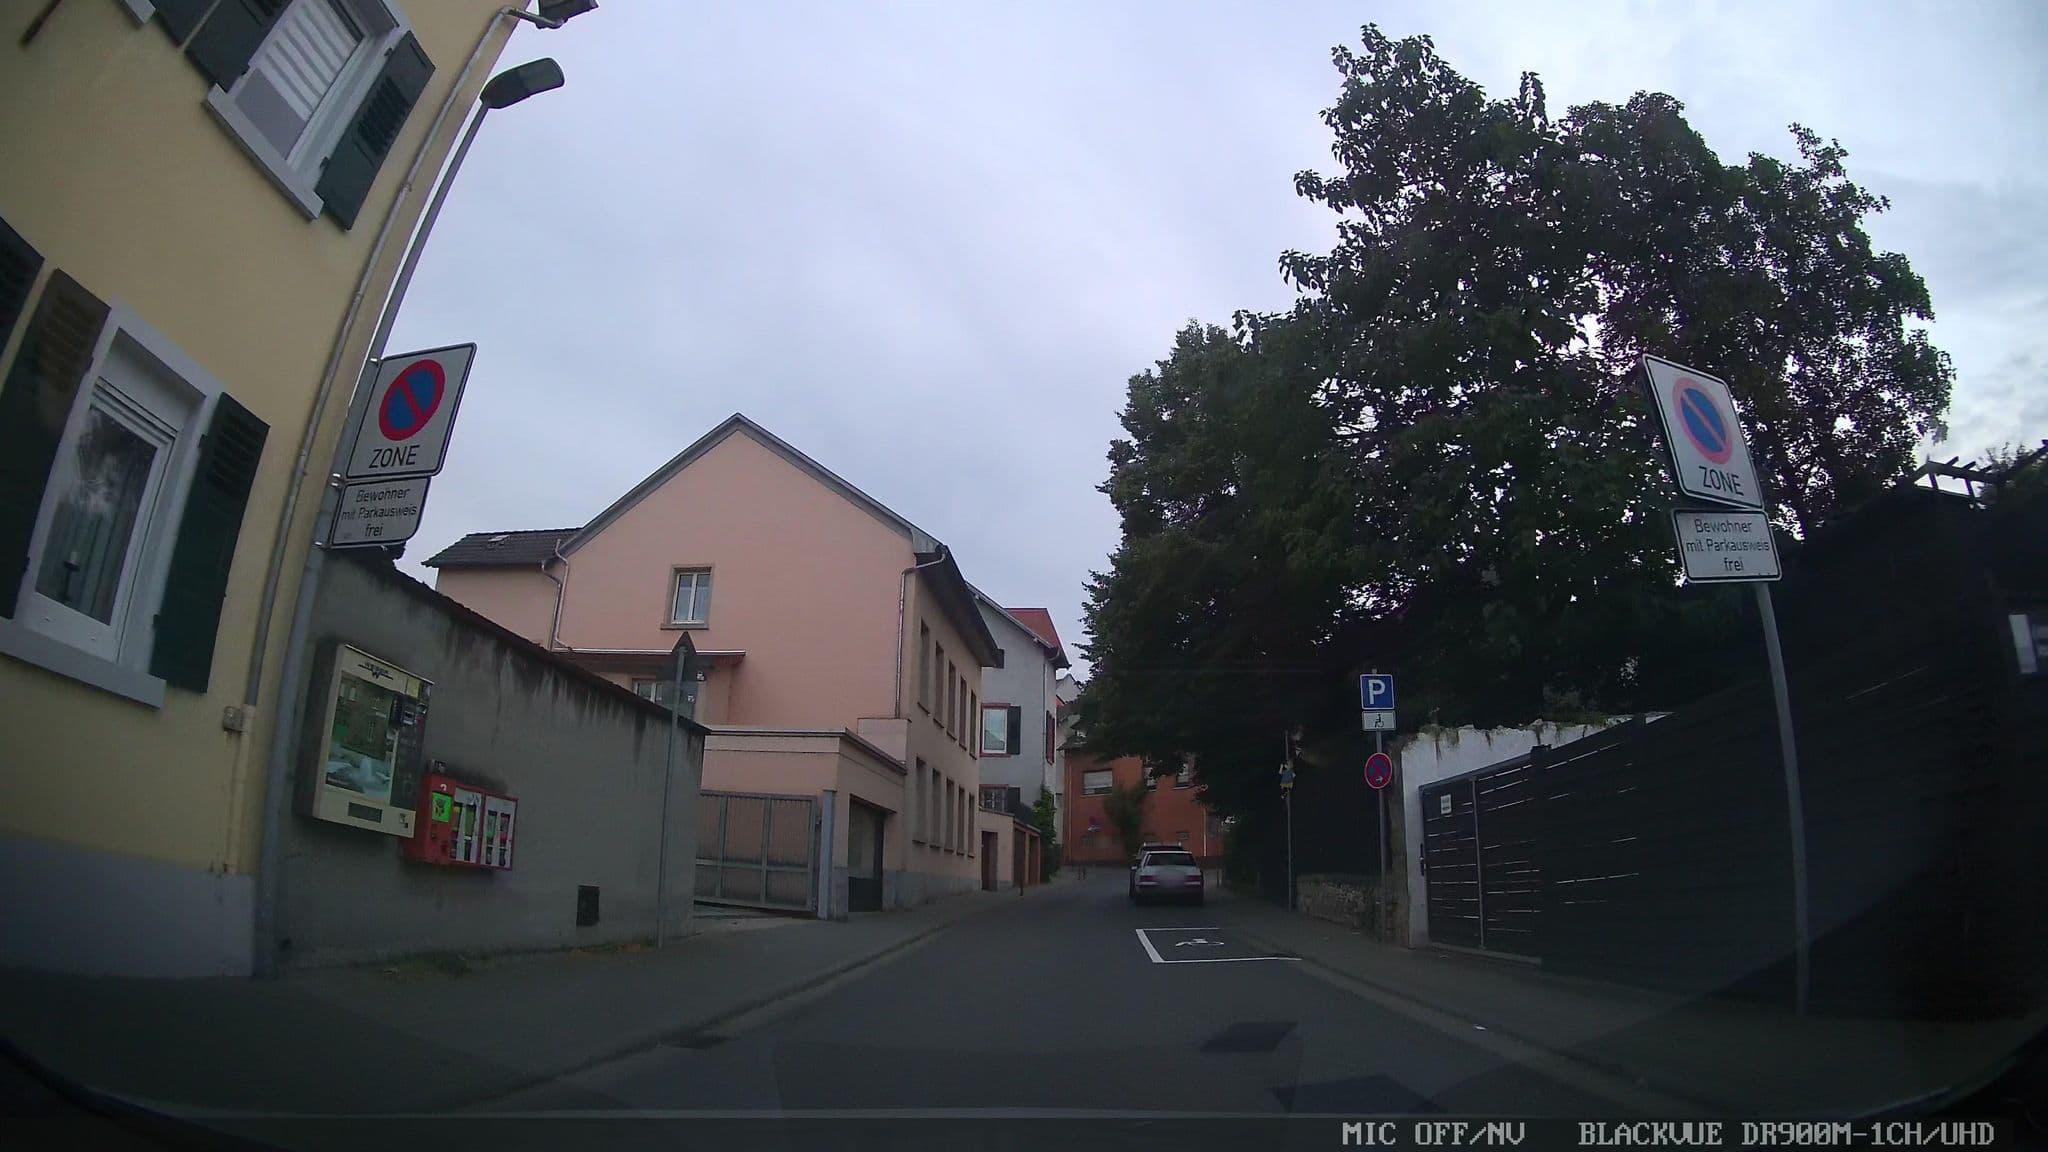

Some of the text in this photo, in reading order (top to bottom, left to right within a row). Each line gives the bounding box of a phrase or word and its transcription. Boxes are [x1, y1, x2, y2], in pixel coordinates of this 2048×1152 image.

[369, 444, 420, 468] ZONE
[1699, 466, 1744, 496] ZONE
[356, 488, 410, 503] Bewohner
[341, 503, 417, 520] mit Parkausweis
[365, 523, 384, 537] frei
[1695, 519, 1752, 533] Bewohner
[1686, 539, 1770, 552] mit Parkausweis
[1724, 557, 1743, 572] frei
[1368, 679, 1385, 705] P
